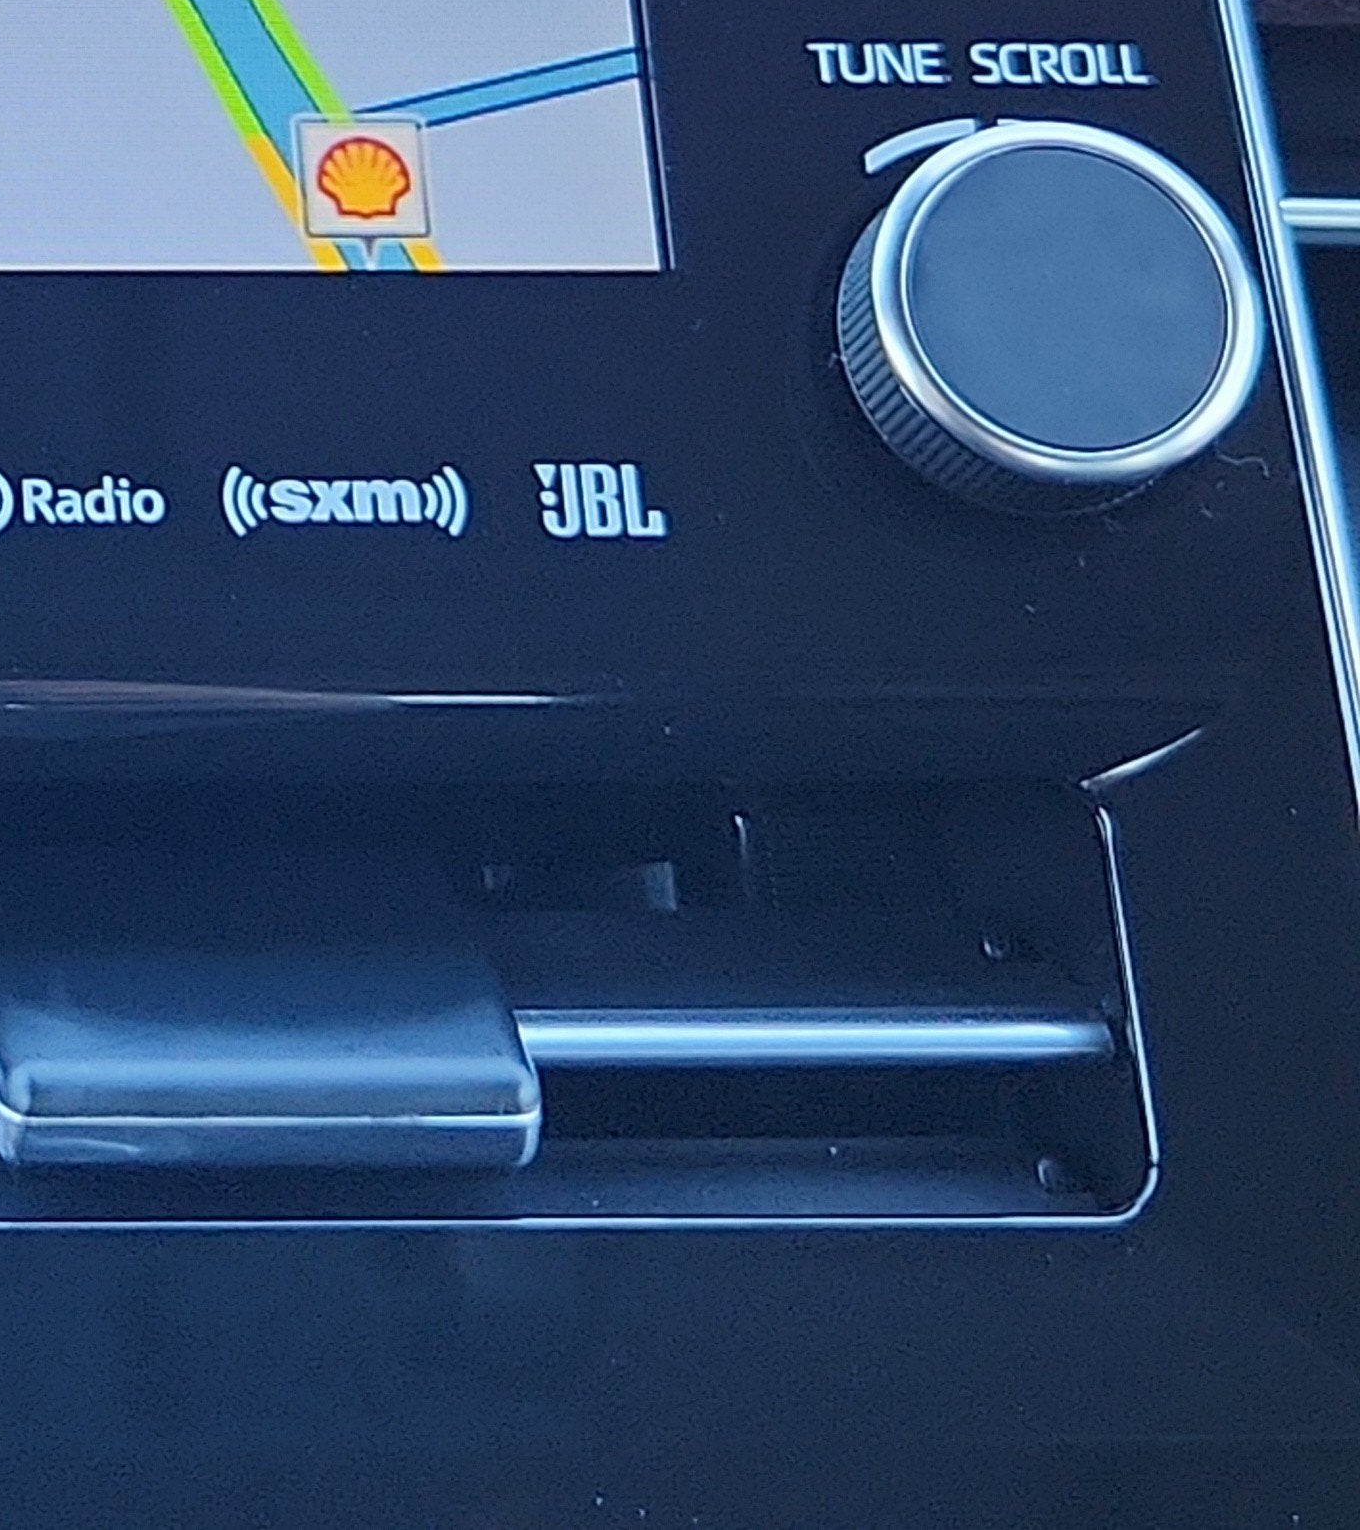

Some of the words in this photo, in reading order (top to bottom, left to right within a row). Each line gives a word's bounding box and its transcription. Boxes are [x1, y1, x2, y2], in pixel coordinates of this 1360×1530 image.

[806, 42, 951, 84] TUNE
[970, 42, 1158, 86] SCROLL
[22, 474, 166, 525] Radio
[270, 475, 420, 523] sxm
[534, 463, 668, 538] JBL
